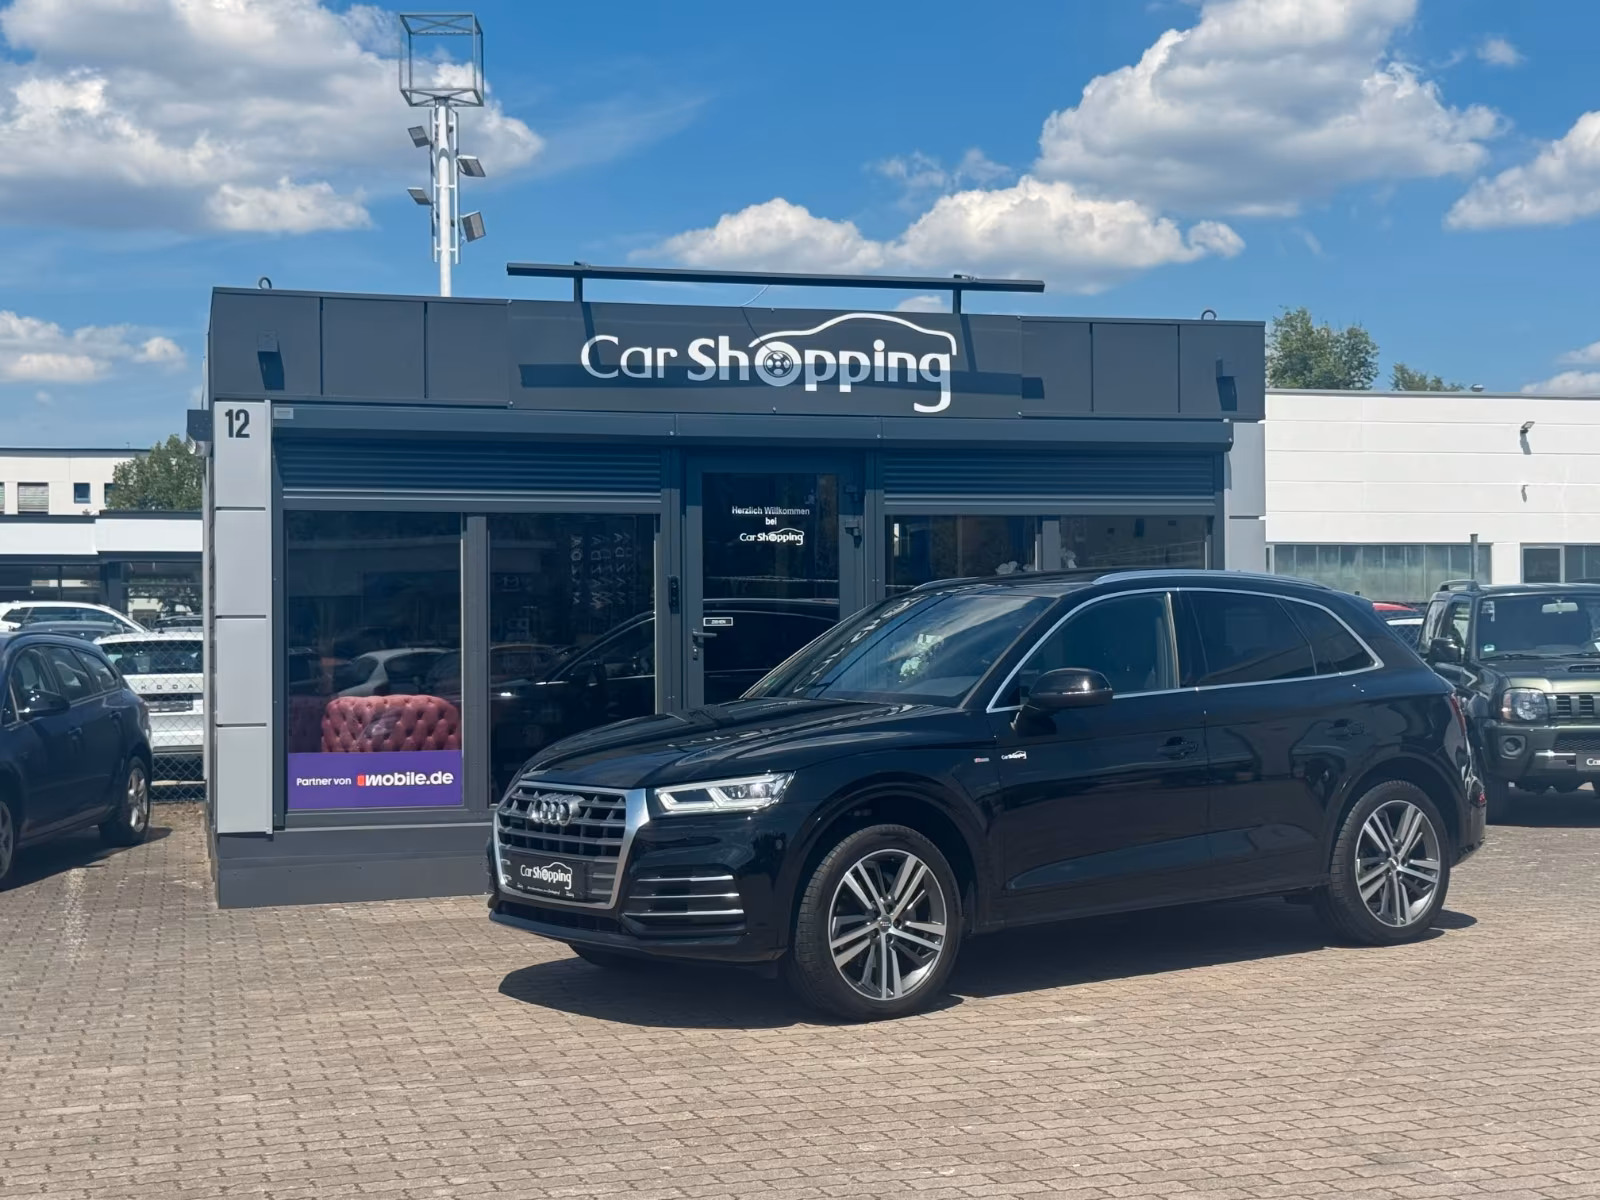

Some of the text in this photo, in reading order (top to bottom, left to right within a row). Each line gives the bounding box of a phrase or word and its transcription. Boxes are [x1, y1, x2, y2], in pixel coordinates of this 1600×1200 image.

[580, 335, 952, 413] Car Shopping
[225, 409, 250, 438] 12
[732, 506, 810, 515] Herzlich Willkommen
[765, 517, 777, 525] bei
[740, 532, 804, 546] Car Shopping
[296, 771, 454, 787] Partner von mobile.de
[520, 864, 572, 889] Car Shopping
